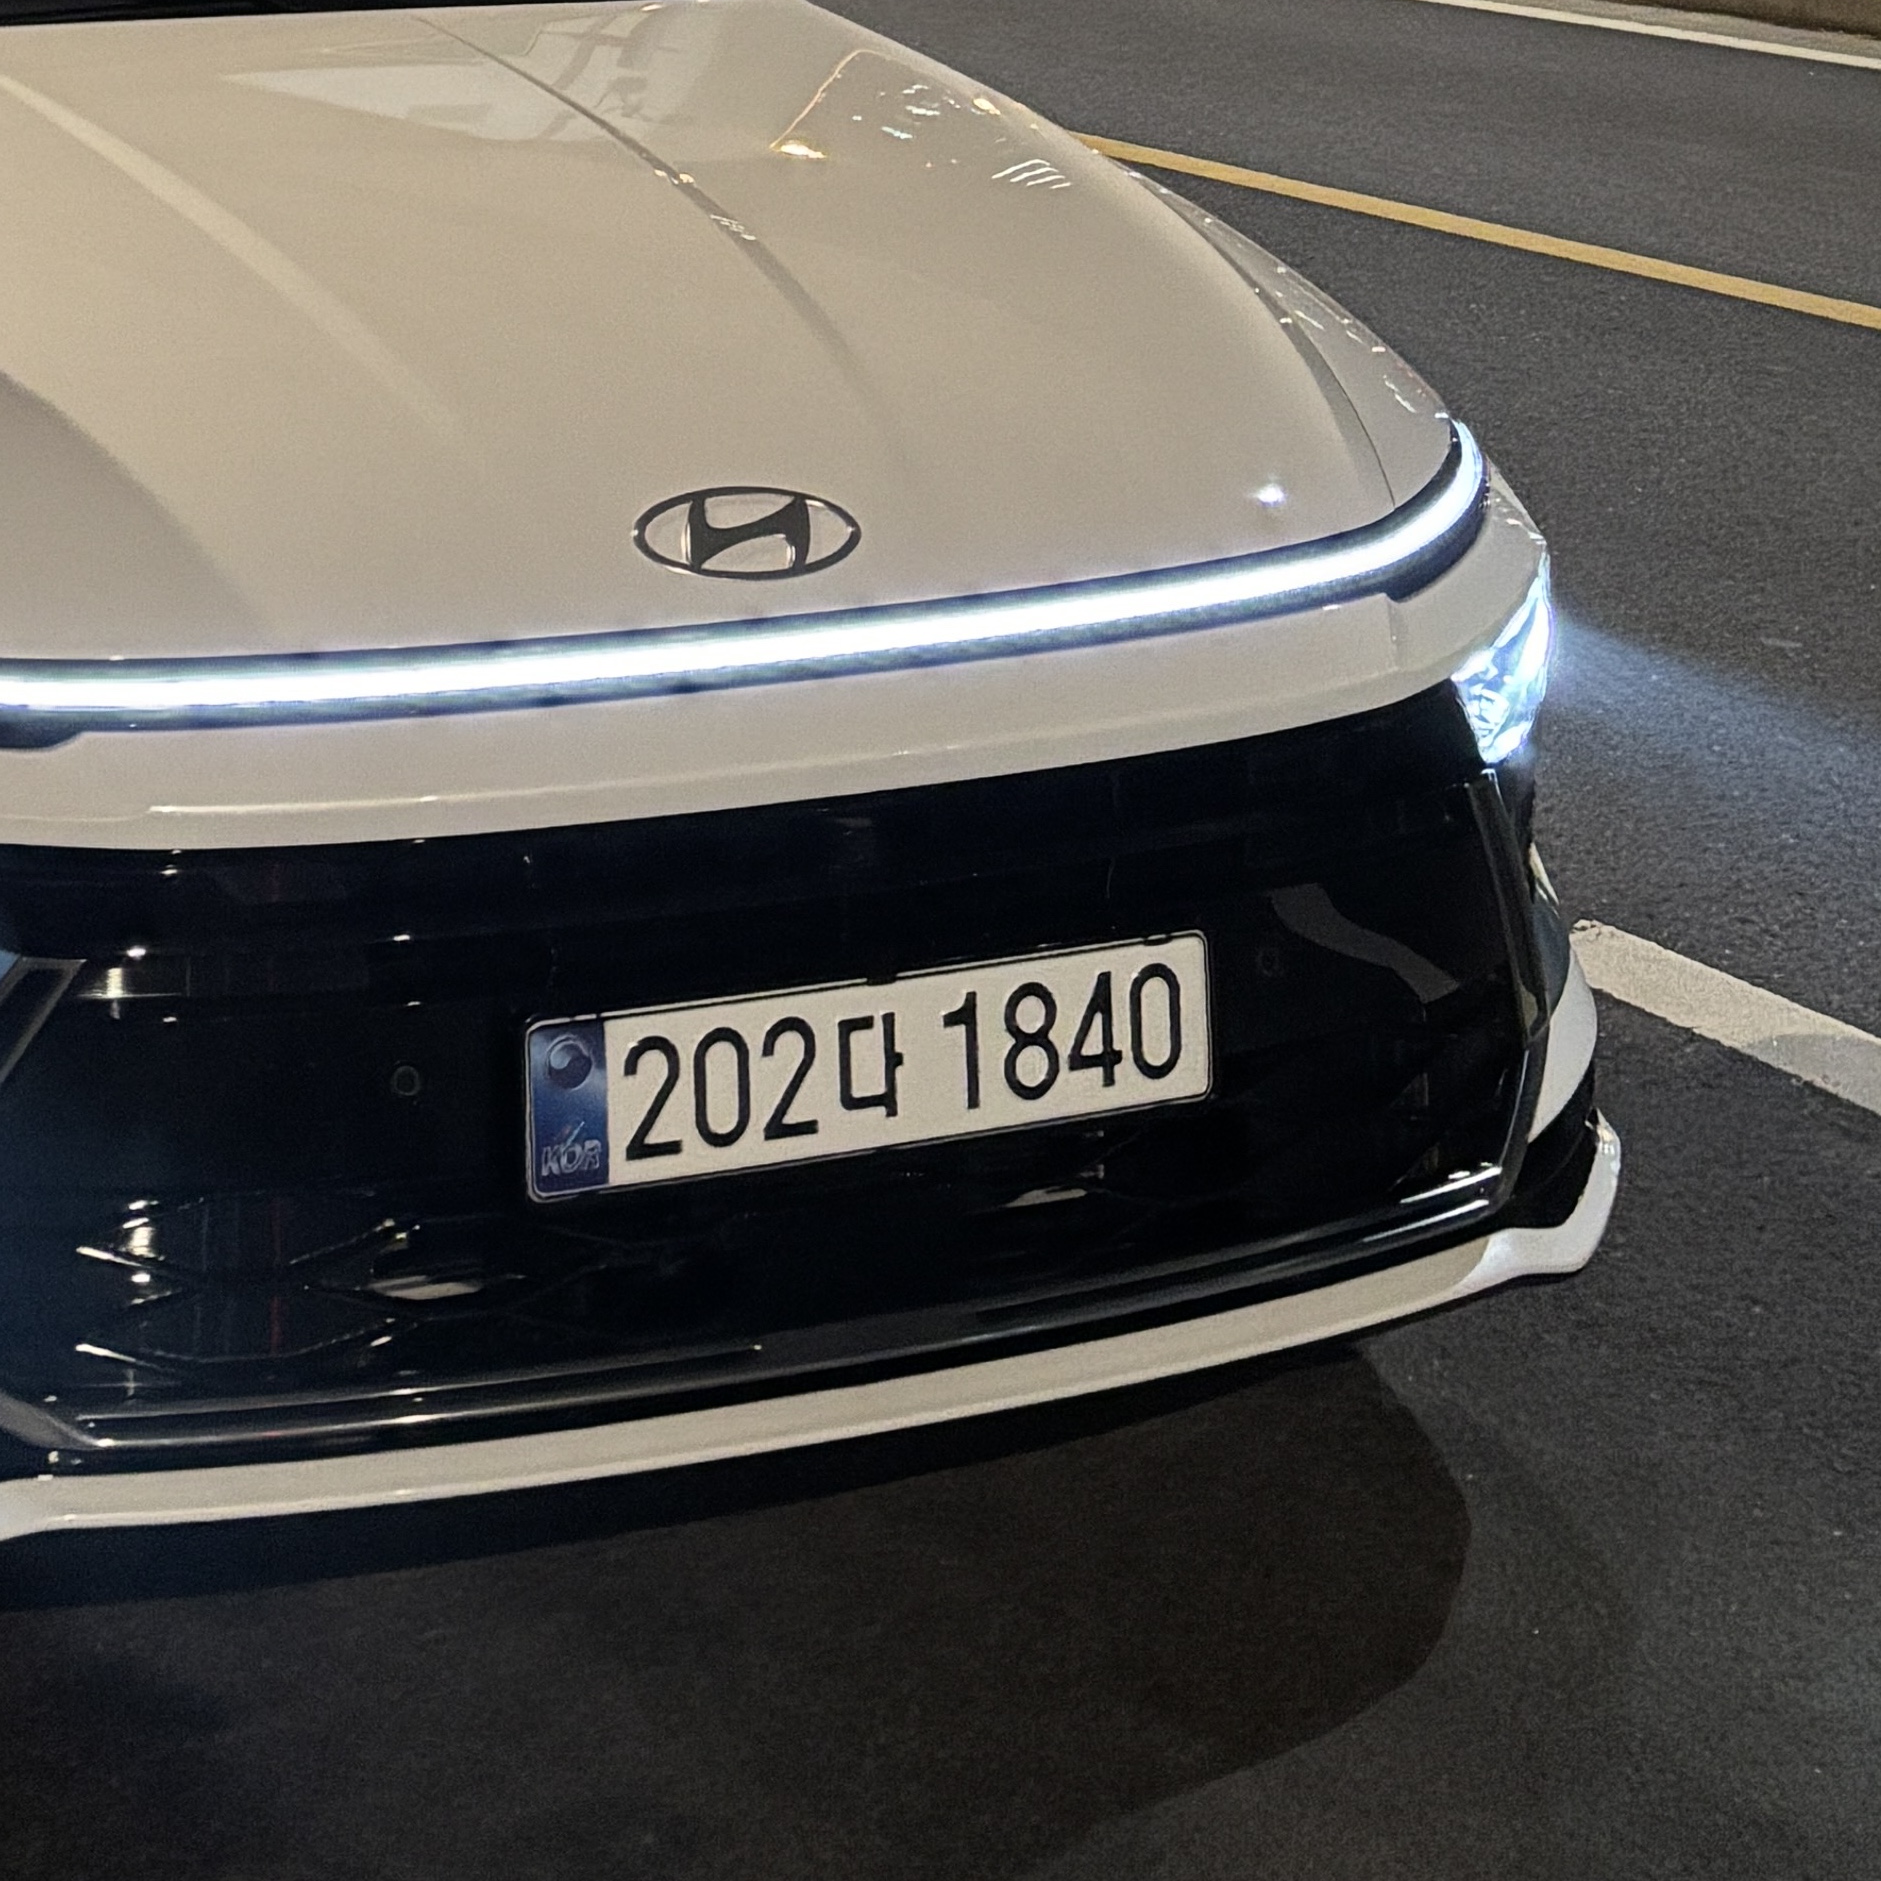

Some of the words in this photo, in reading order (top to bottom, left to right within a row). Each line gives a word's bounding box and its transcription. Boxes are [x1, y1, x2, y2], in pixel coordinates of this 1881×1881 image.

[623, 1011, 903, 1161] 202다
[942, 962, 1182, 1110] 1840
[541, 1139, 602, 1176] KOR
